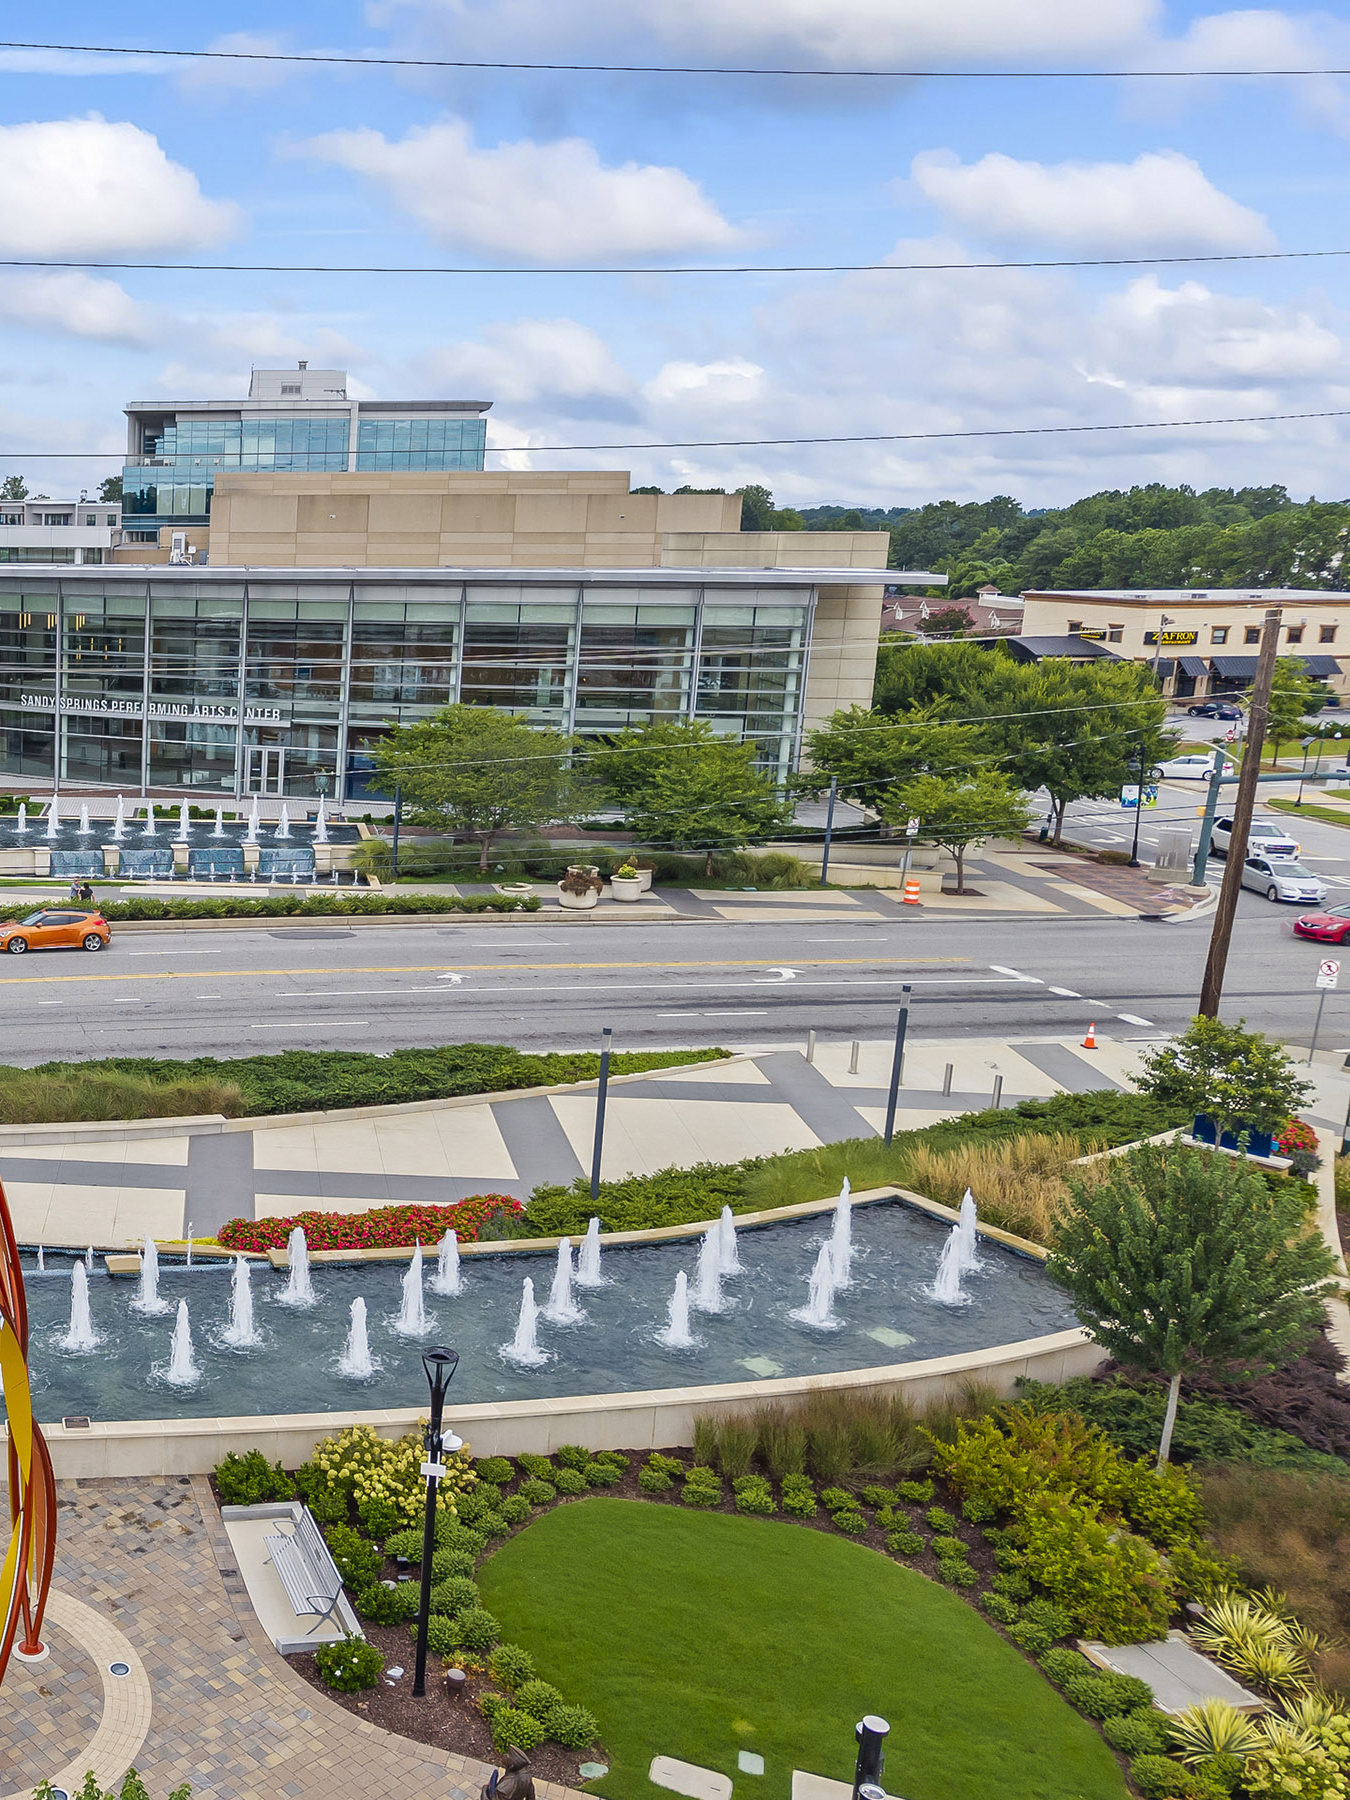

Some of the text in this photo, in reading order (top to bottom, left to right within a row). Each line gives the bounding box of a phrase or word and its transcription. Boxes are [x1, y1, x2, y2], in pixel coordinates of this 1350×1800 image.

[1152, 631, 1195, 640] ZAFRON
[20, 694, 56, 708] SANDY
[60, 697, 108, 712] SPRINGS
[193, 705, 225, 719] ARTS
[229, 706, 280, 721] CNTER
